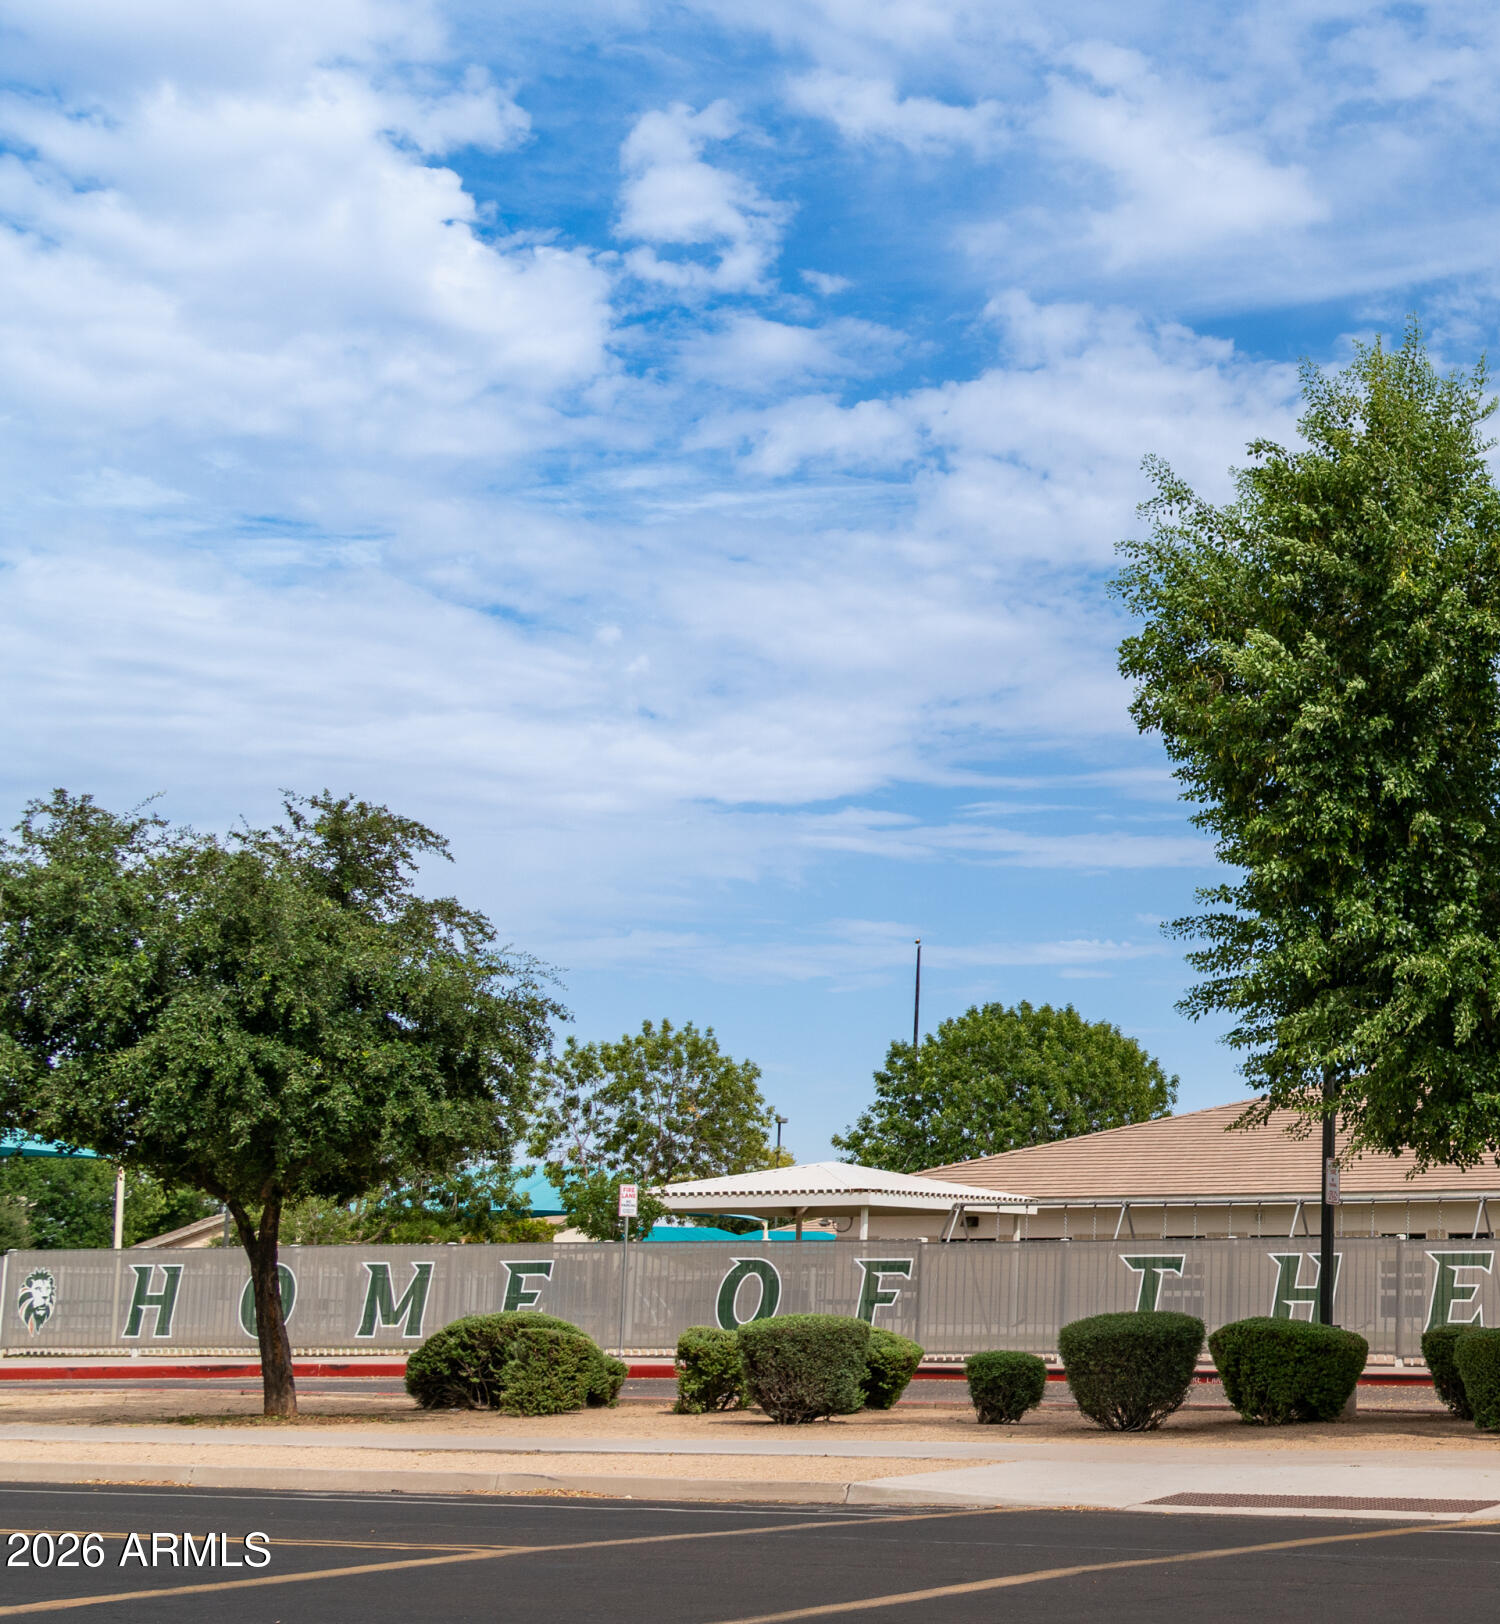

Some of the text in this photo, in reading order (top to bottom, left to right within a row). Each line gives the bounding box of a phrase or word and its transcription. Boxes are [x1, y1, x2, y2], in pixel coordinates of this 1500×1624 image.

[121, 1260, 555, 1338] HOME
[715, 1257, 914, 1330] OF
[1118, 1250, 1495, 1333] THE
